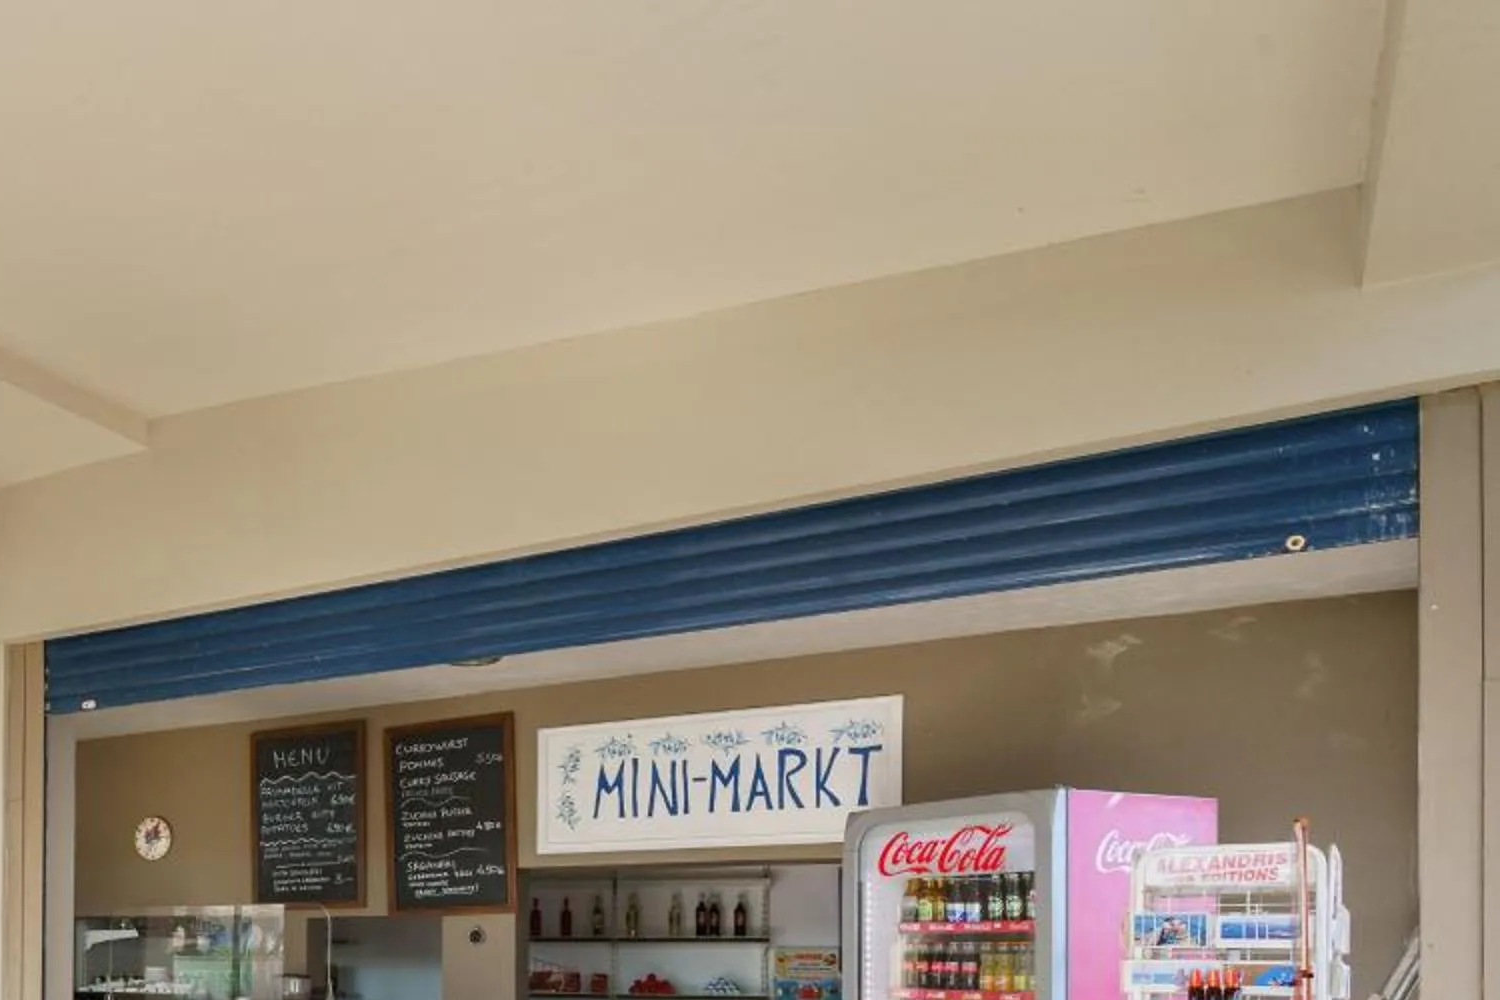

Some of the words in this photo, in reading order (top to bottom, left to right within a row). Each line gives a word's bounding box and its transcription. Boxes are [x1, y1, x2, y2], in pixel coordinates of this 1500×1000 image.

[273, 747, 330, 769] MENU
[593, 744, 882, 819] MINI-MARKT
[878, 824, 1014, 876] Coca-Cola
[1157, 852, 1288, 874] ALEXANDRIS
